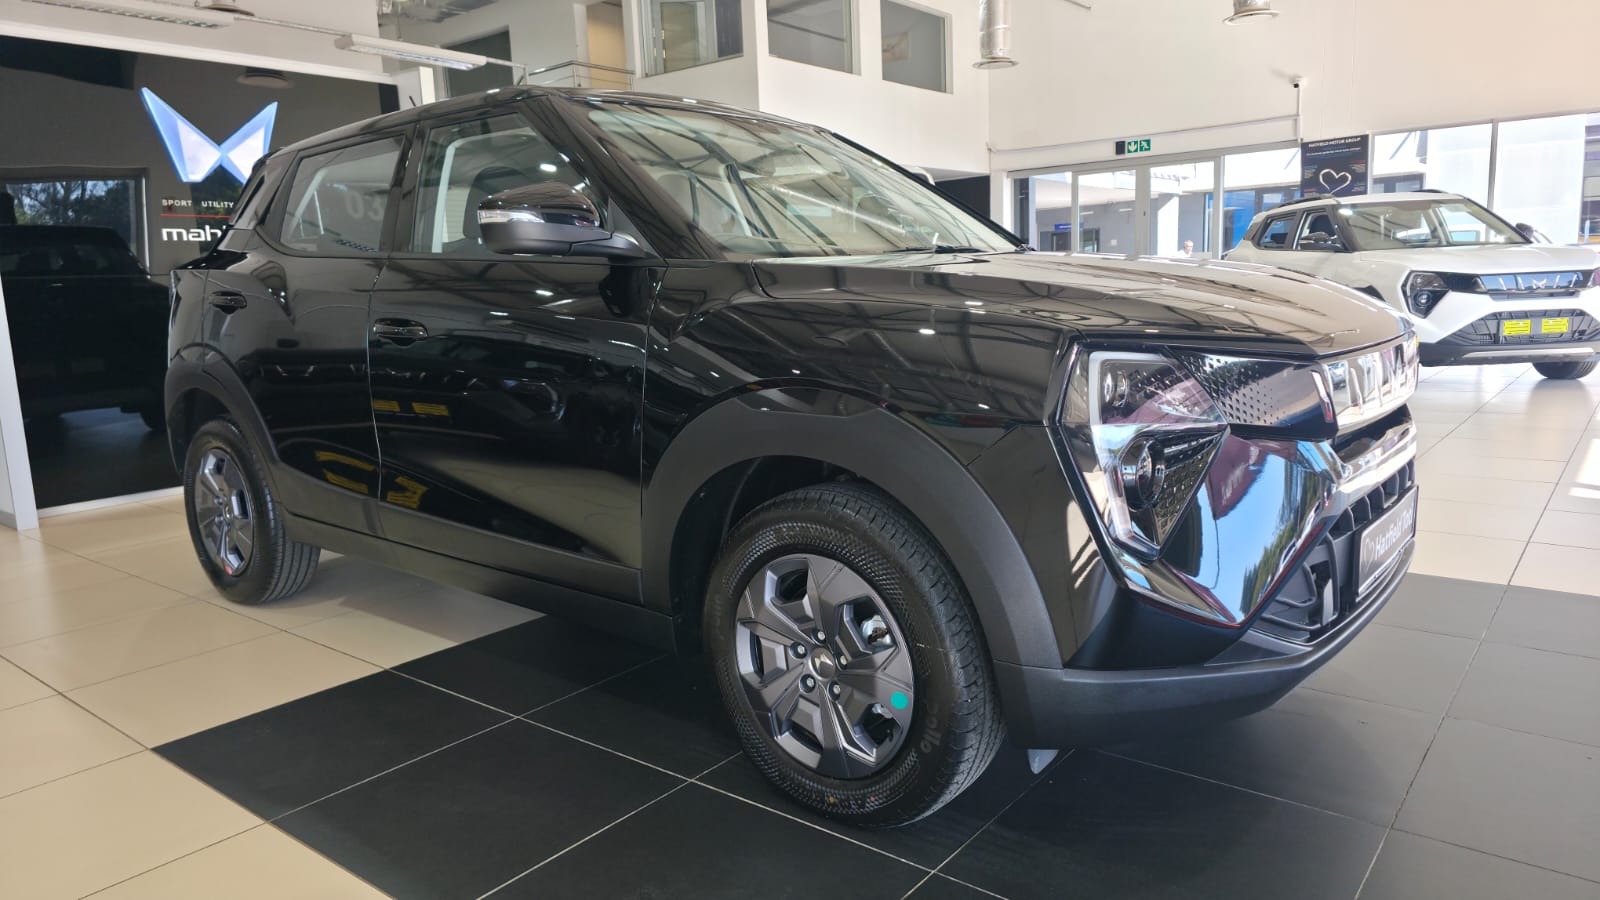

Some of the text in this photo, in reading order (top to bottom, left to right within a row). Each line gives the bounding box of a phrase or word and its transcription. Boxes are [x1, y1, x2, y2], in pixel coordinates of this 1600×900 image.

[162, 199, 234, 208] SPORT UTILITY
[162, 225, 226, 241] mah
